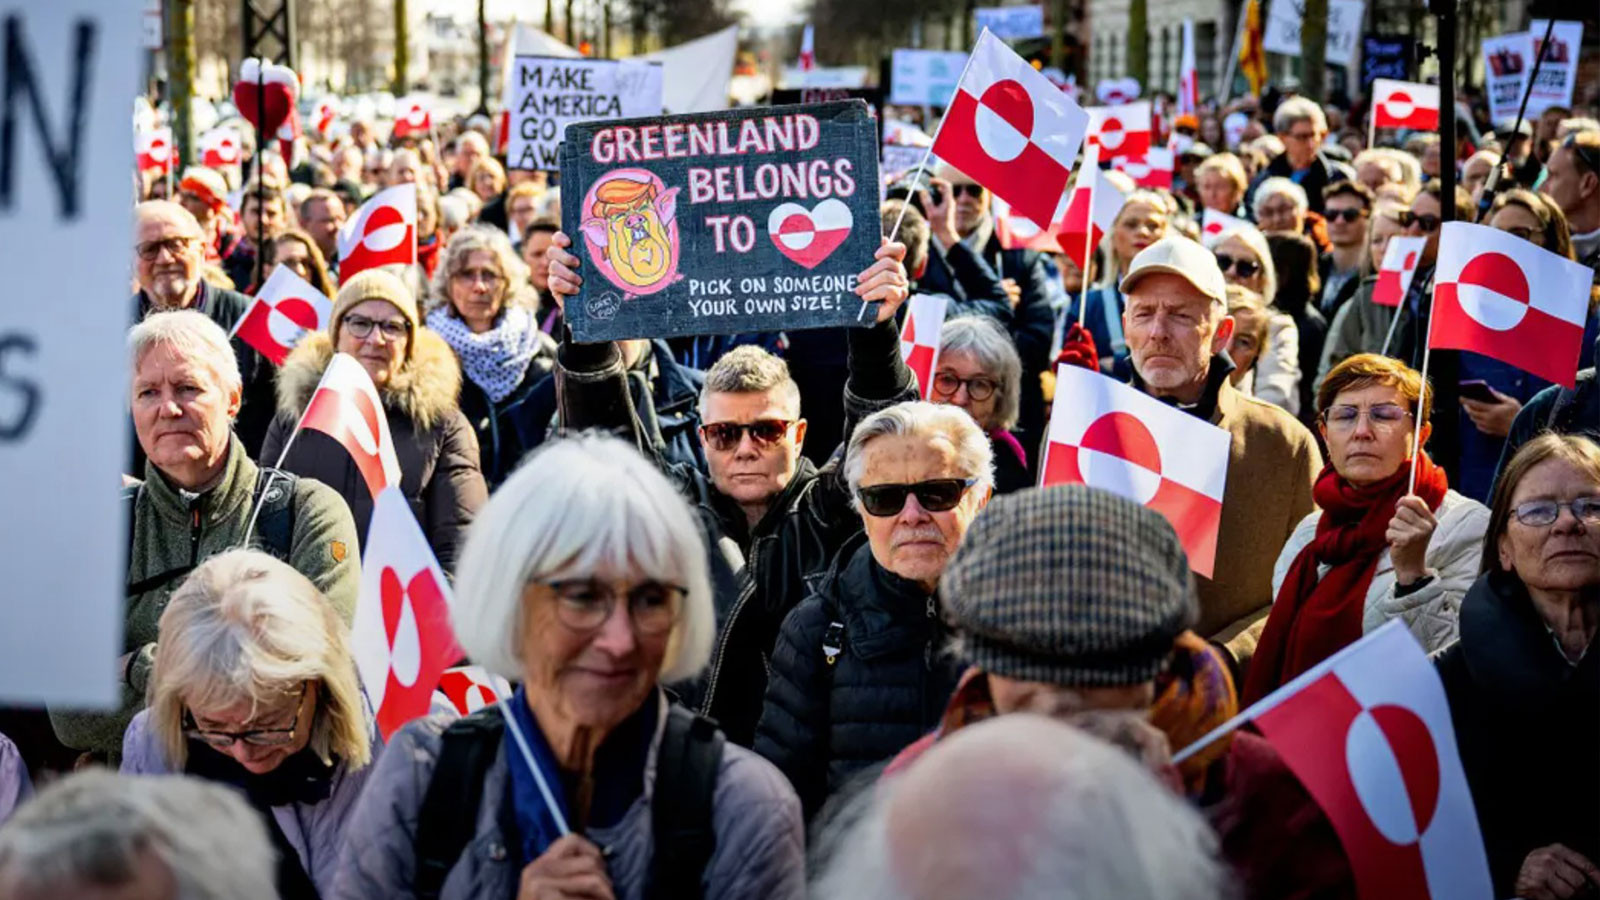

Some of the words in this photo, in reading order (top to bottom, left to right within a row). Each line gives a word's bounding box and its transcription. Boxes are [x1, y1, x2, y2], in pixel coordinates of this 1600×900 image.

[521, 65, 595, 91] MAKE
[520, 92, 622, 117] AMERICA
[520, 116, 556, 141] GO
[590, 113, 821, 165] GREENLAND
[519, 143, 558, 169] AW
[688, 157, 855, 204] BELONGS
[705, 214, 756, 253] TO
[689, 278, 732, 296] PICK
[740, 276, 767, 294] ON
[773, 274, 858, 294] SOMEONE
[688, 299, 738, 317] YOUR
[744, 298, 786, 315] OWN
[790, 293, 841, 312] SIZE!
